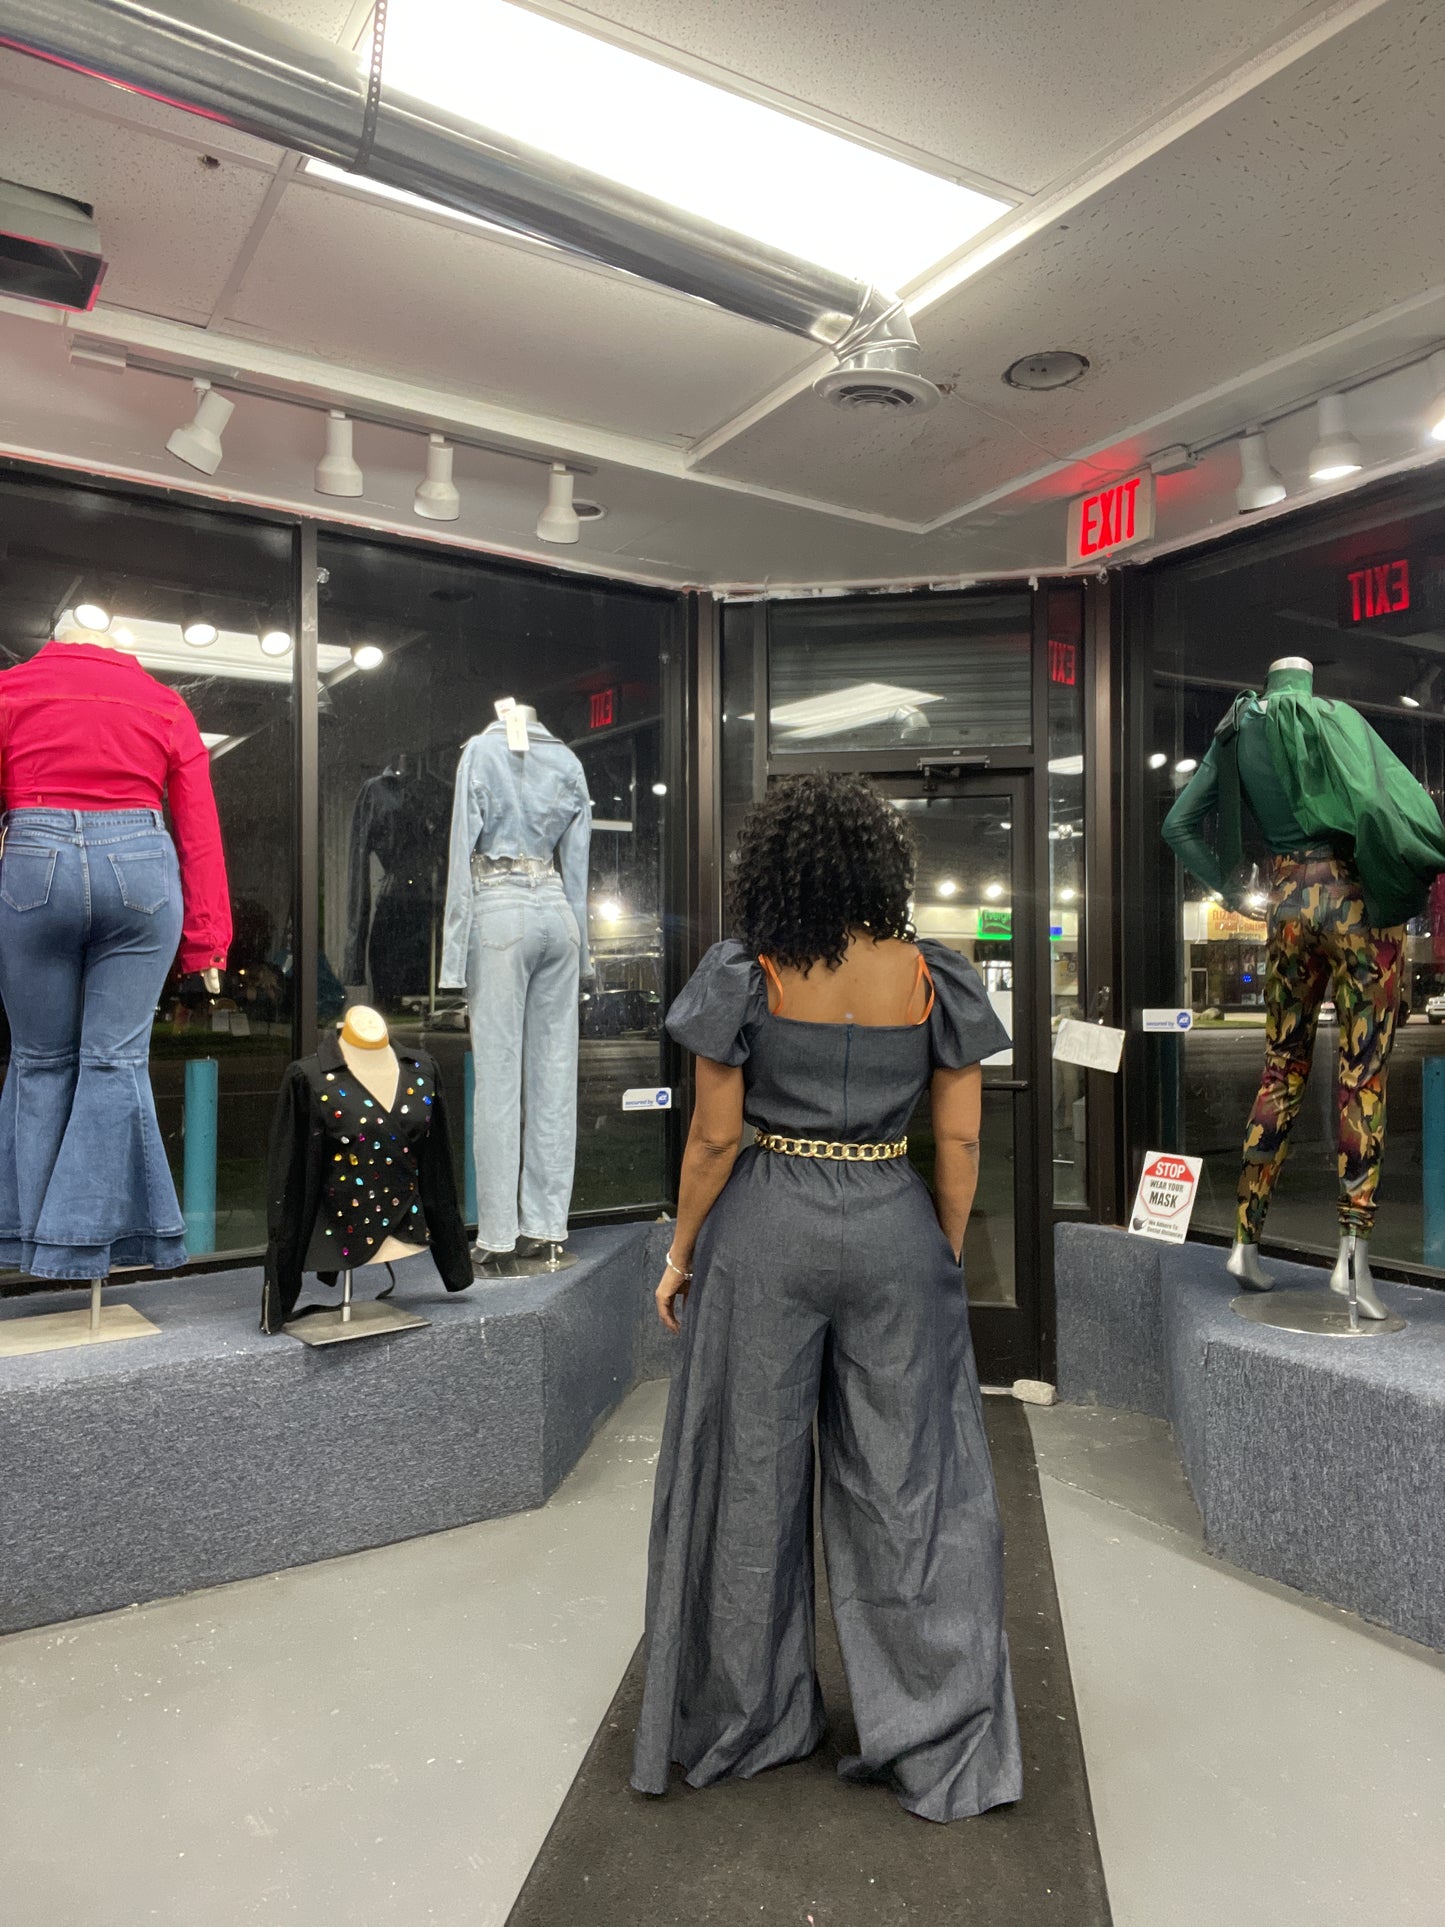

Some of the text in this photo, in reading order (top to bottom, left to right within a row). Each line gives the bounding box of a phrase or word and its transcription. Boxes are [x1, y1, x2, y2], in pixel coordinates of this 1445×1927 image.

[1080, 478, 1140, 557] EXIT
[1155, 1161, 1186, 1179] STOP
[1150, 1180, 1184, 1193] WEAR YOUR
[1149, 1191, 1178, 1209] MASK
